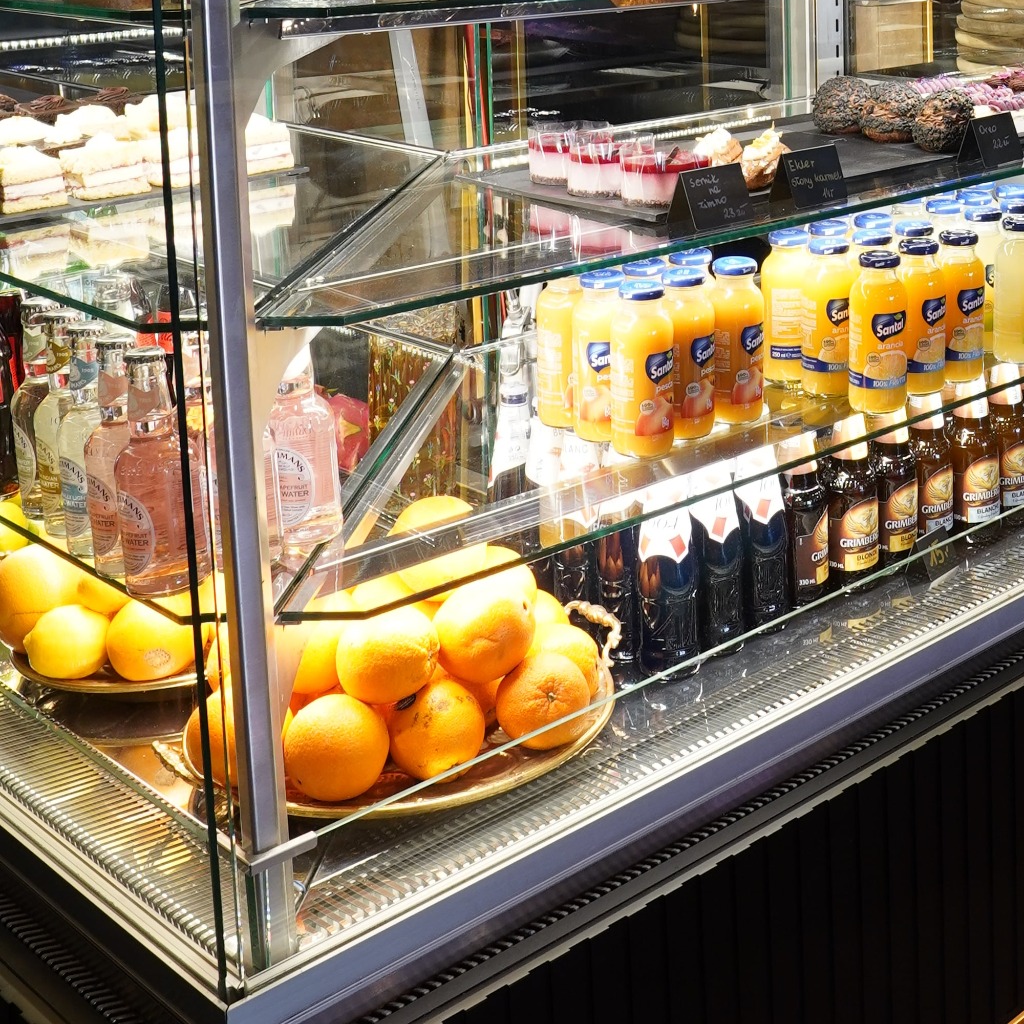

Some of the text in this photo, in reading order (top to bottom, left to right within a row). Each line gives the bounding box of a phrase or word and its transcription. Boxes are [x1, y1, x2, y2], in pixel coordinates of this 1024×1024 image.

[831, 308, 849, 322] San
[926, 304, 946, 322] Santa
[832, 326, 849, 334] aran
[876, 317, 904, 337] Santal
[877, 341, 903, 350] arancia
[591, 354, 610, 368] San
[281, 490, 309, 498] WATER
